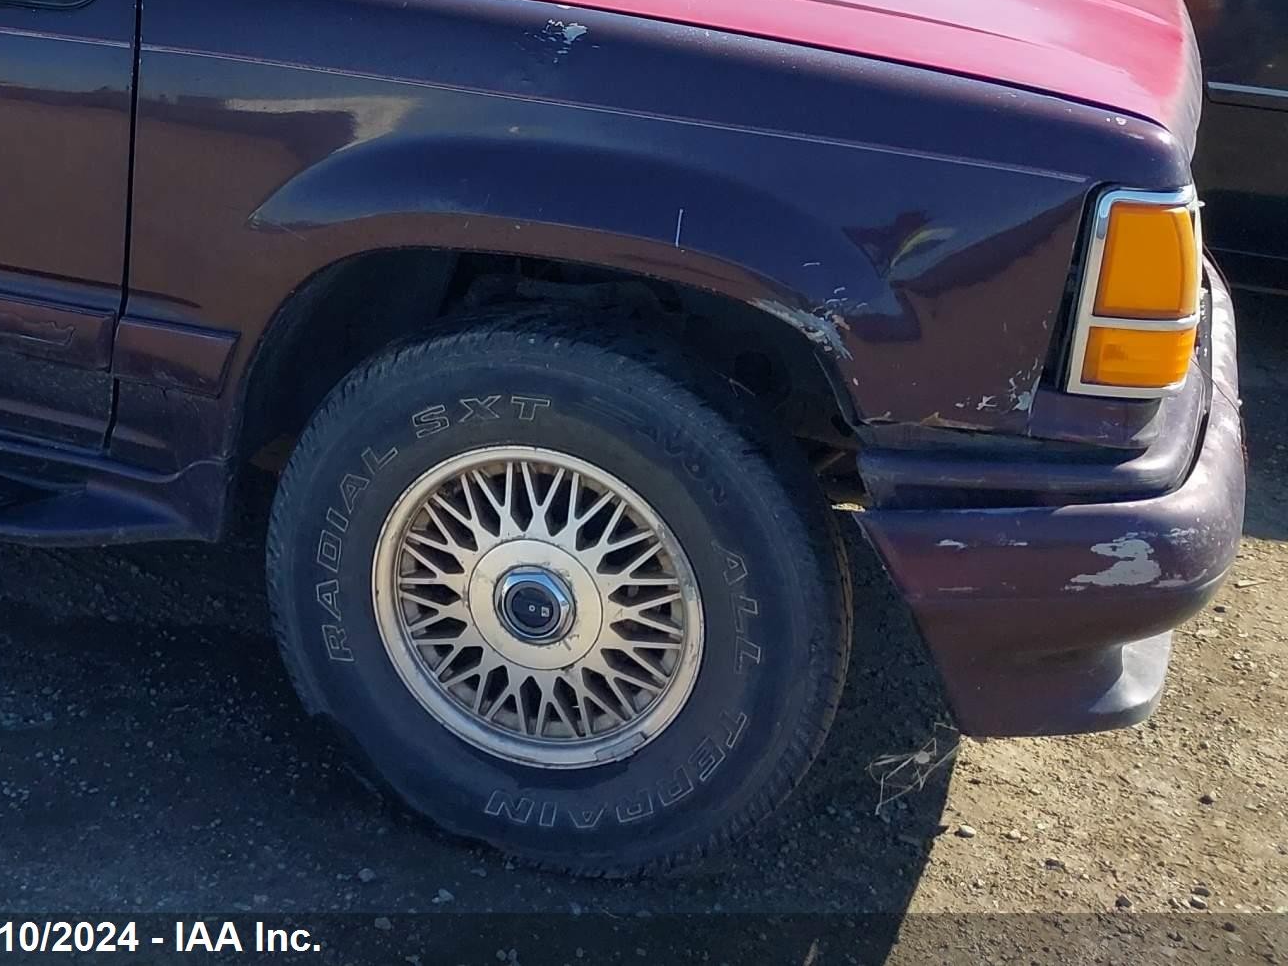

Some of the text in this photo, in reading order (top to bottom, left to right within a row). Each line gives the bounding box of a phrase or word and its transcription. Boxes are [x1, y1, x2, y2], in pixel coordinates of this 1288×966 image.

[316, 394, 552, 662] RADIAL SXT
[484, 539, 762, 829] ALL TERRAIN
